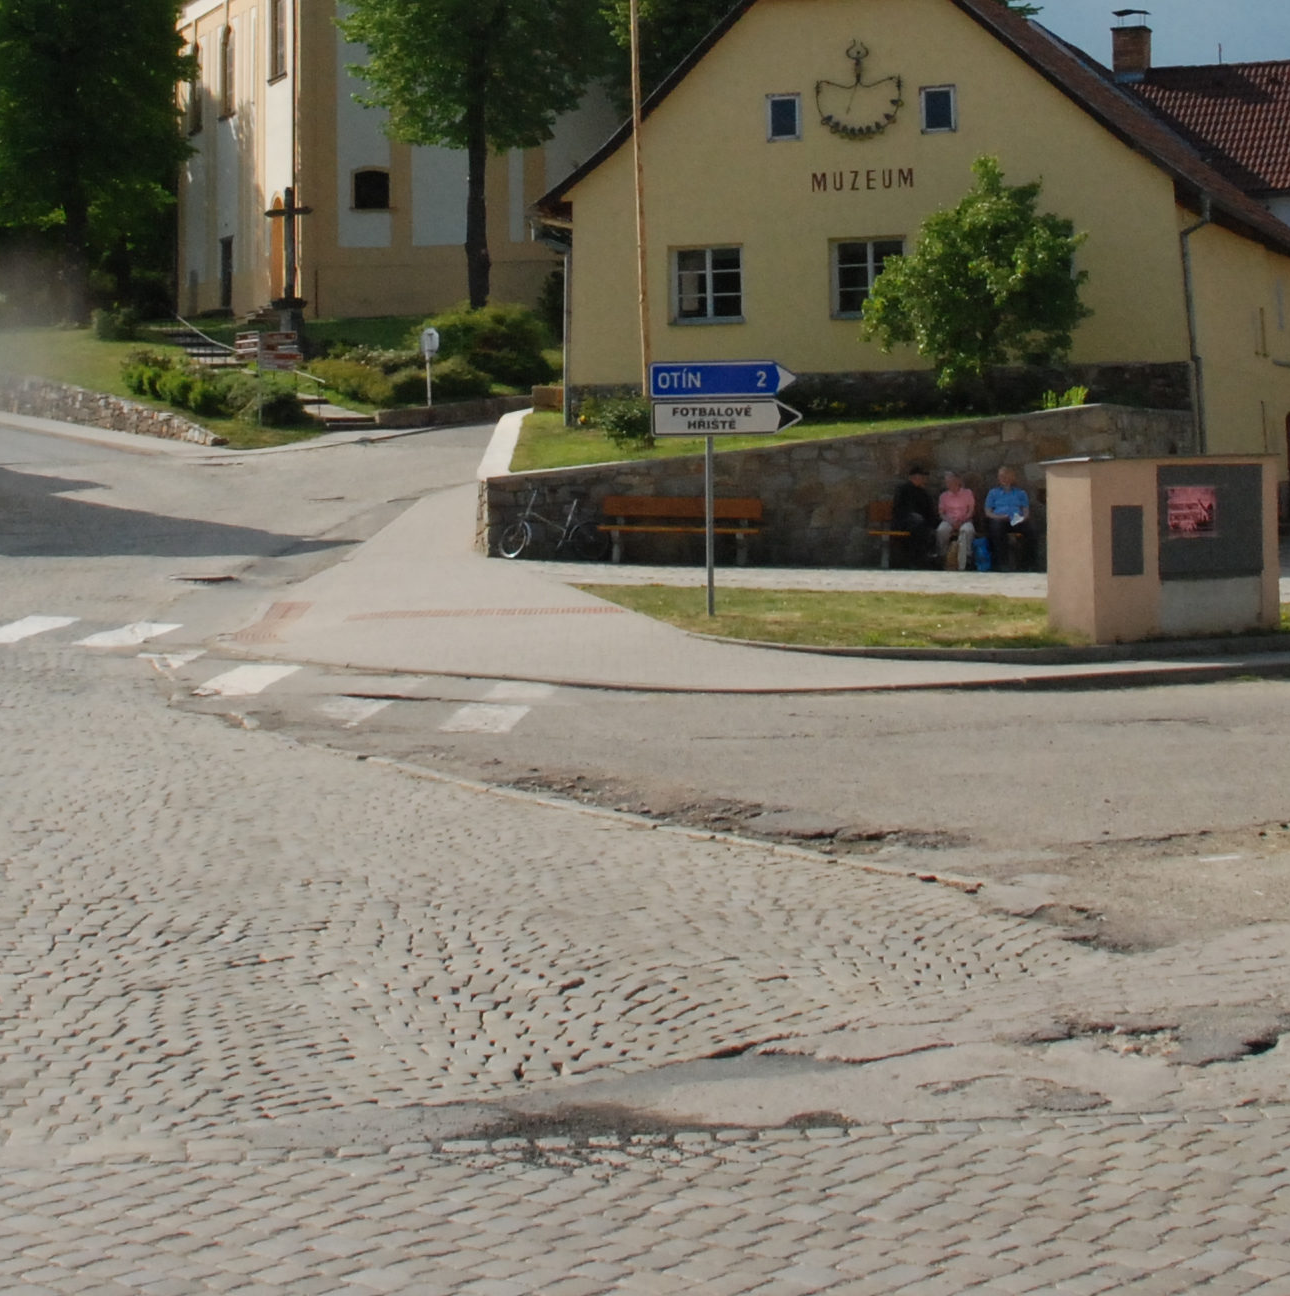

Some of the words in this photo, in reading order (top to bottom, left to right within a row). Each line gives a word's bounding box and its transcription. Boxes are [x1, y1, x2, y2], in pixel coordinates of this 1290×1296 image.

[811, 168, 914, 192] MUZEUM
[658, 368, 701, 389] OTÍN
[756, 371, 767, 388] 2
[672, 405, 752, 417] FOTBALOVÉ
[687, 418, 736, 430] HŘIŠTĚ
